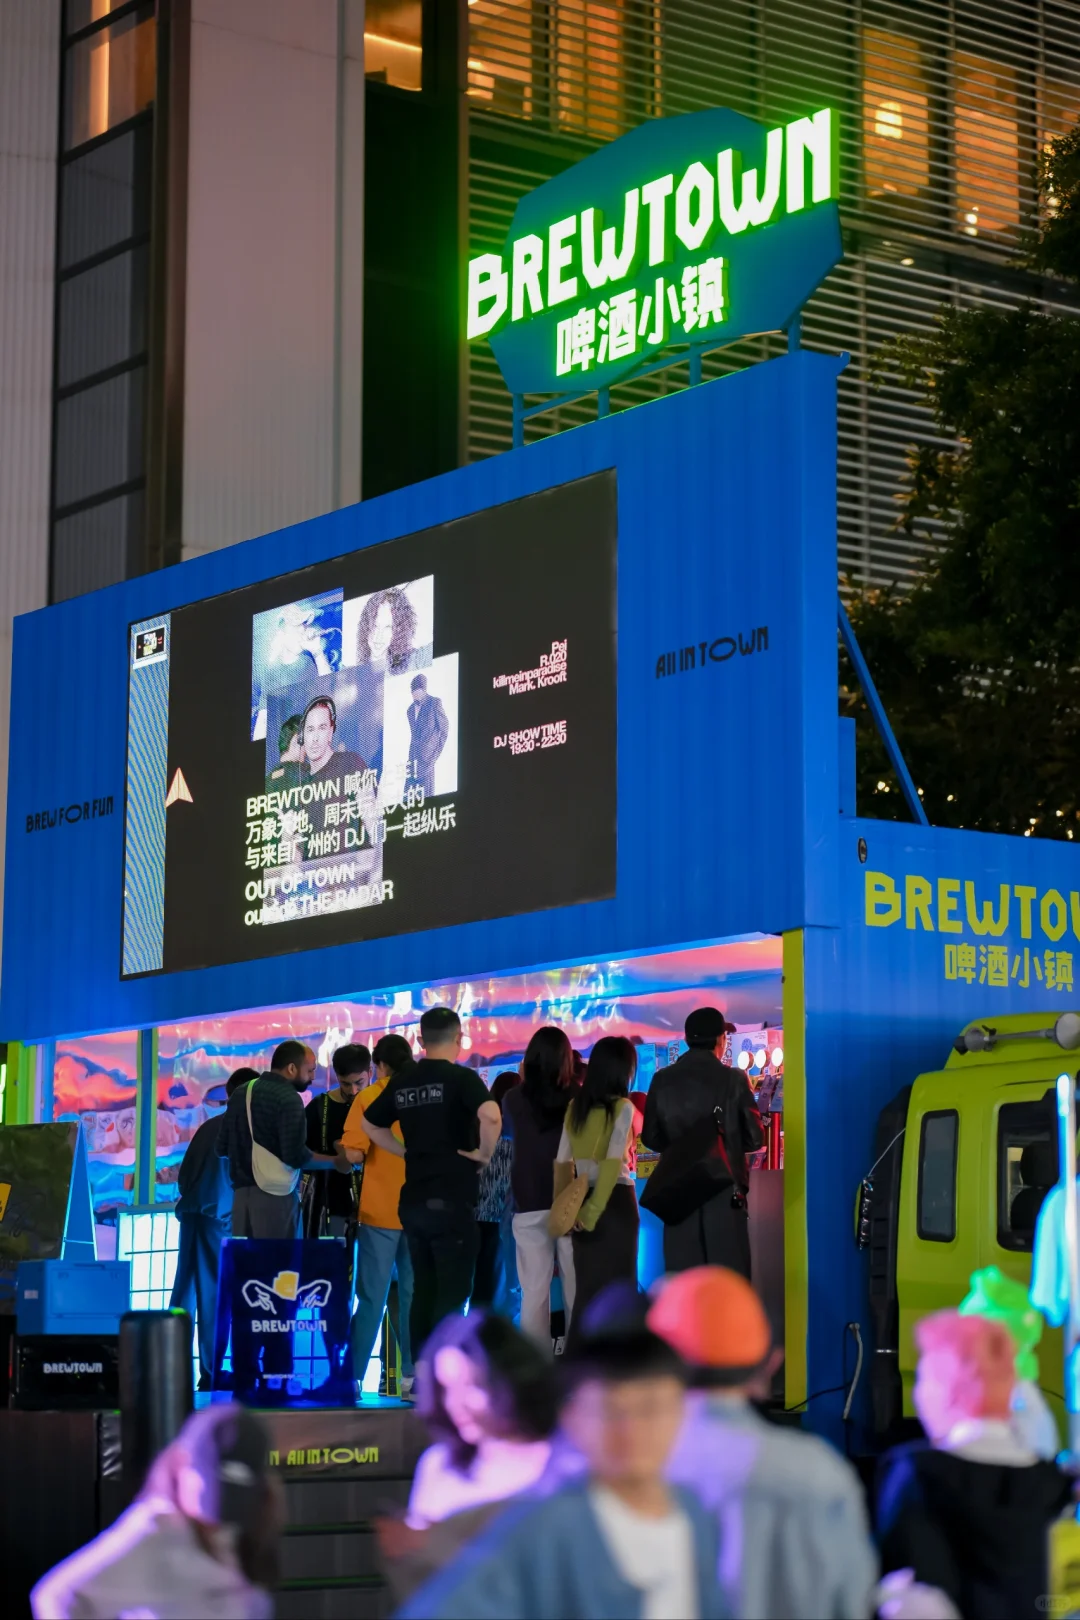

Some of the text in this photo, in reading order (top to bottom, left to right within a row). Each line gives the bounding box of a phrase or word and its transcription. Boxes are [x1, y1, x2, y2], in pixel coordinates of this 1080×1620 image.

[467, 108, 837, 339] BREWTOWN
[556, 258, 728, 376] 啤酒小镇
[552, 639, 567, 653] Pei
[493, 720, 567, 748] DJ SHOW TIME
[510, 740, 534, 755] 19:30
[541, 732, 567, 749] 22:30
[26, 796, 114, 834] BREW FOR FUN
[246, 777, 340, 818] BREWTOWN
[345, 828, 365, 848] DJ
[245, 863, 355, 902] OUT OF TOWN
[865, 871, 1080, 942] BREWTO
[944, 943, 1074, 992] 啤酒小镇
[251, 1319, 327, 1332] BREWTOWN
[43, 1363, 102, 1373] BREWTOWN
